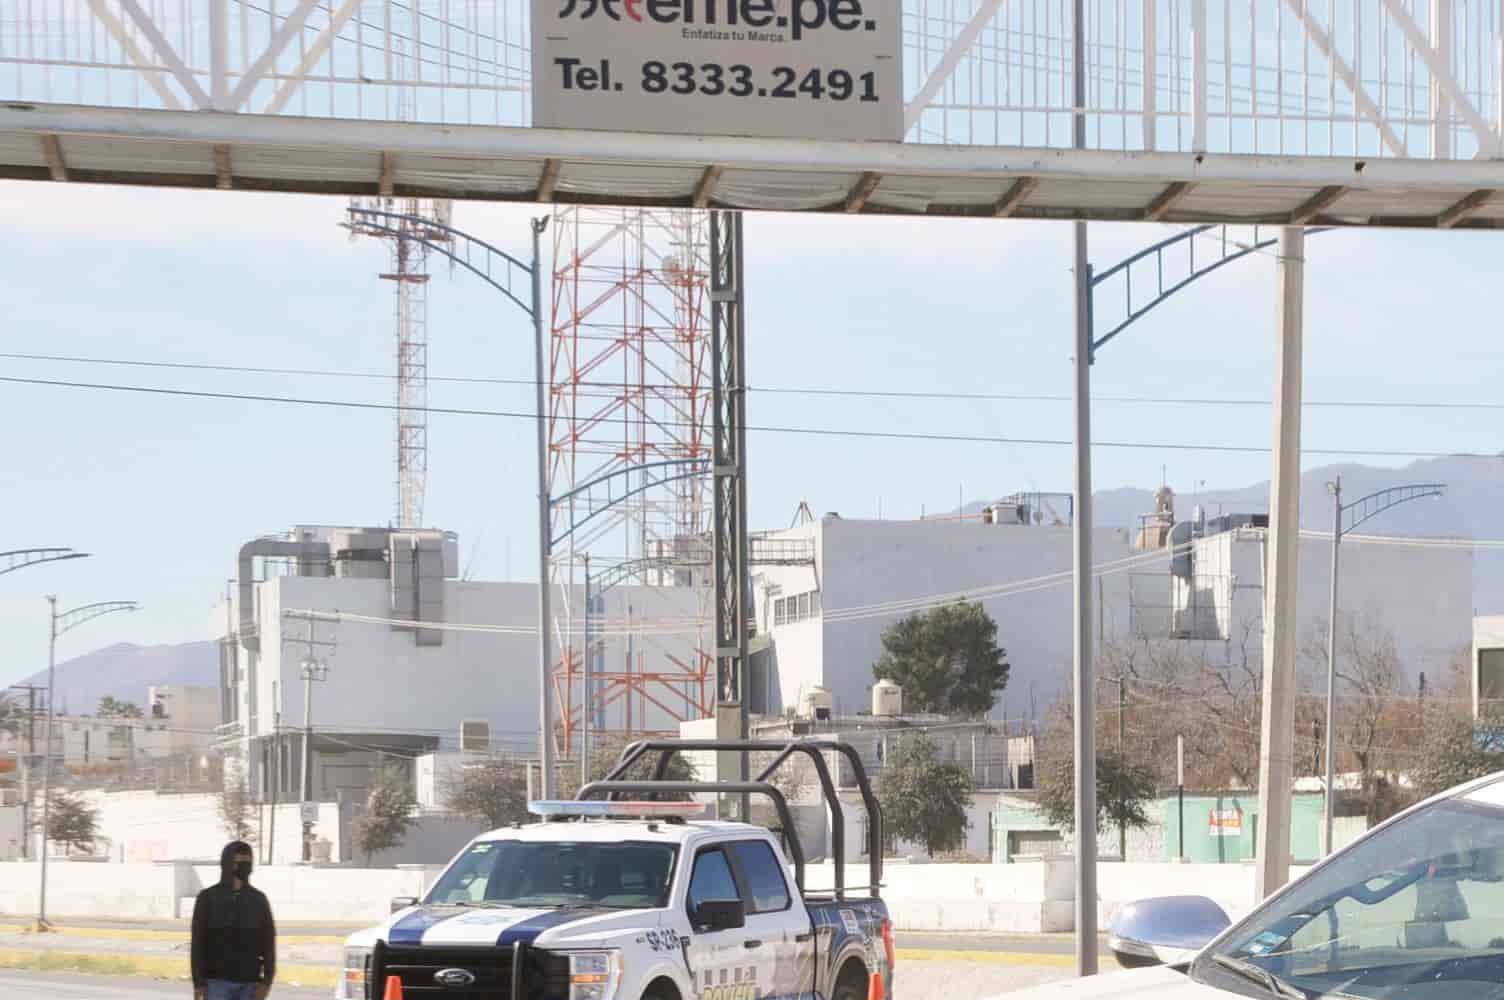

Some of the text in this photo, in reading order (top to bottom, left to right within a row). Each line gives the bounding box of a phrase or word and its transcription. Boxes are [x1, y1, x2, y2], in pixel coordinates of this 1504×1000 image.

[681, 27, 729, 41] Enfatiza
[732, 31, 745, 41] tu
[553, 57, 880, 102] Tel. 8333.2491
